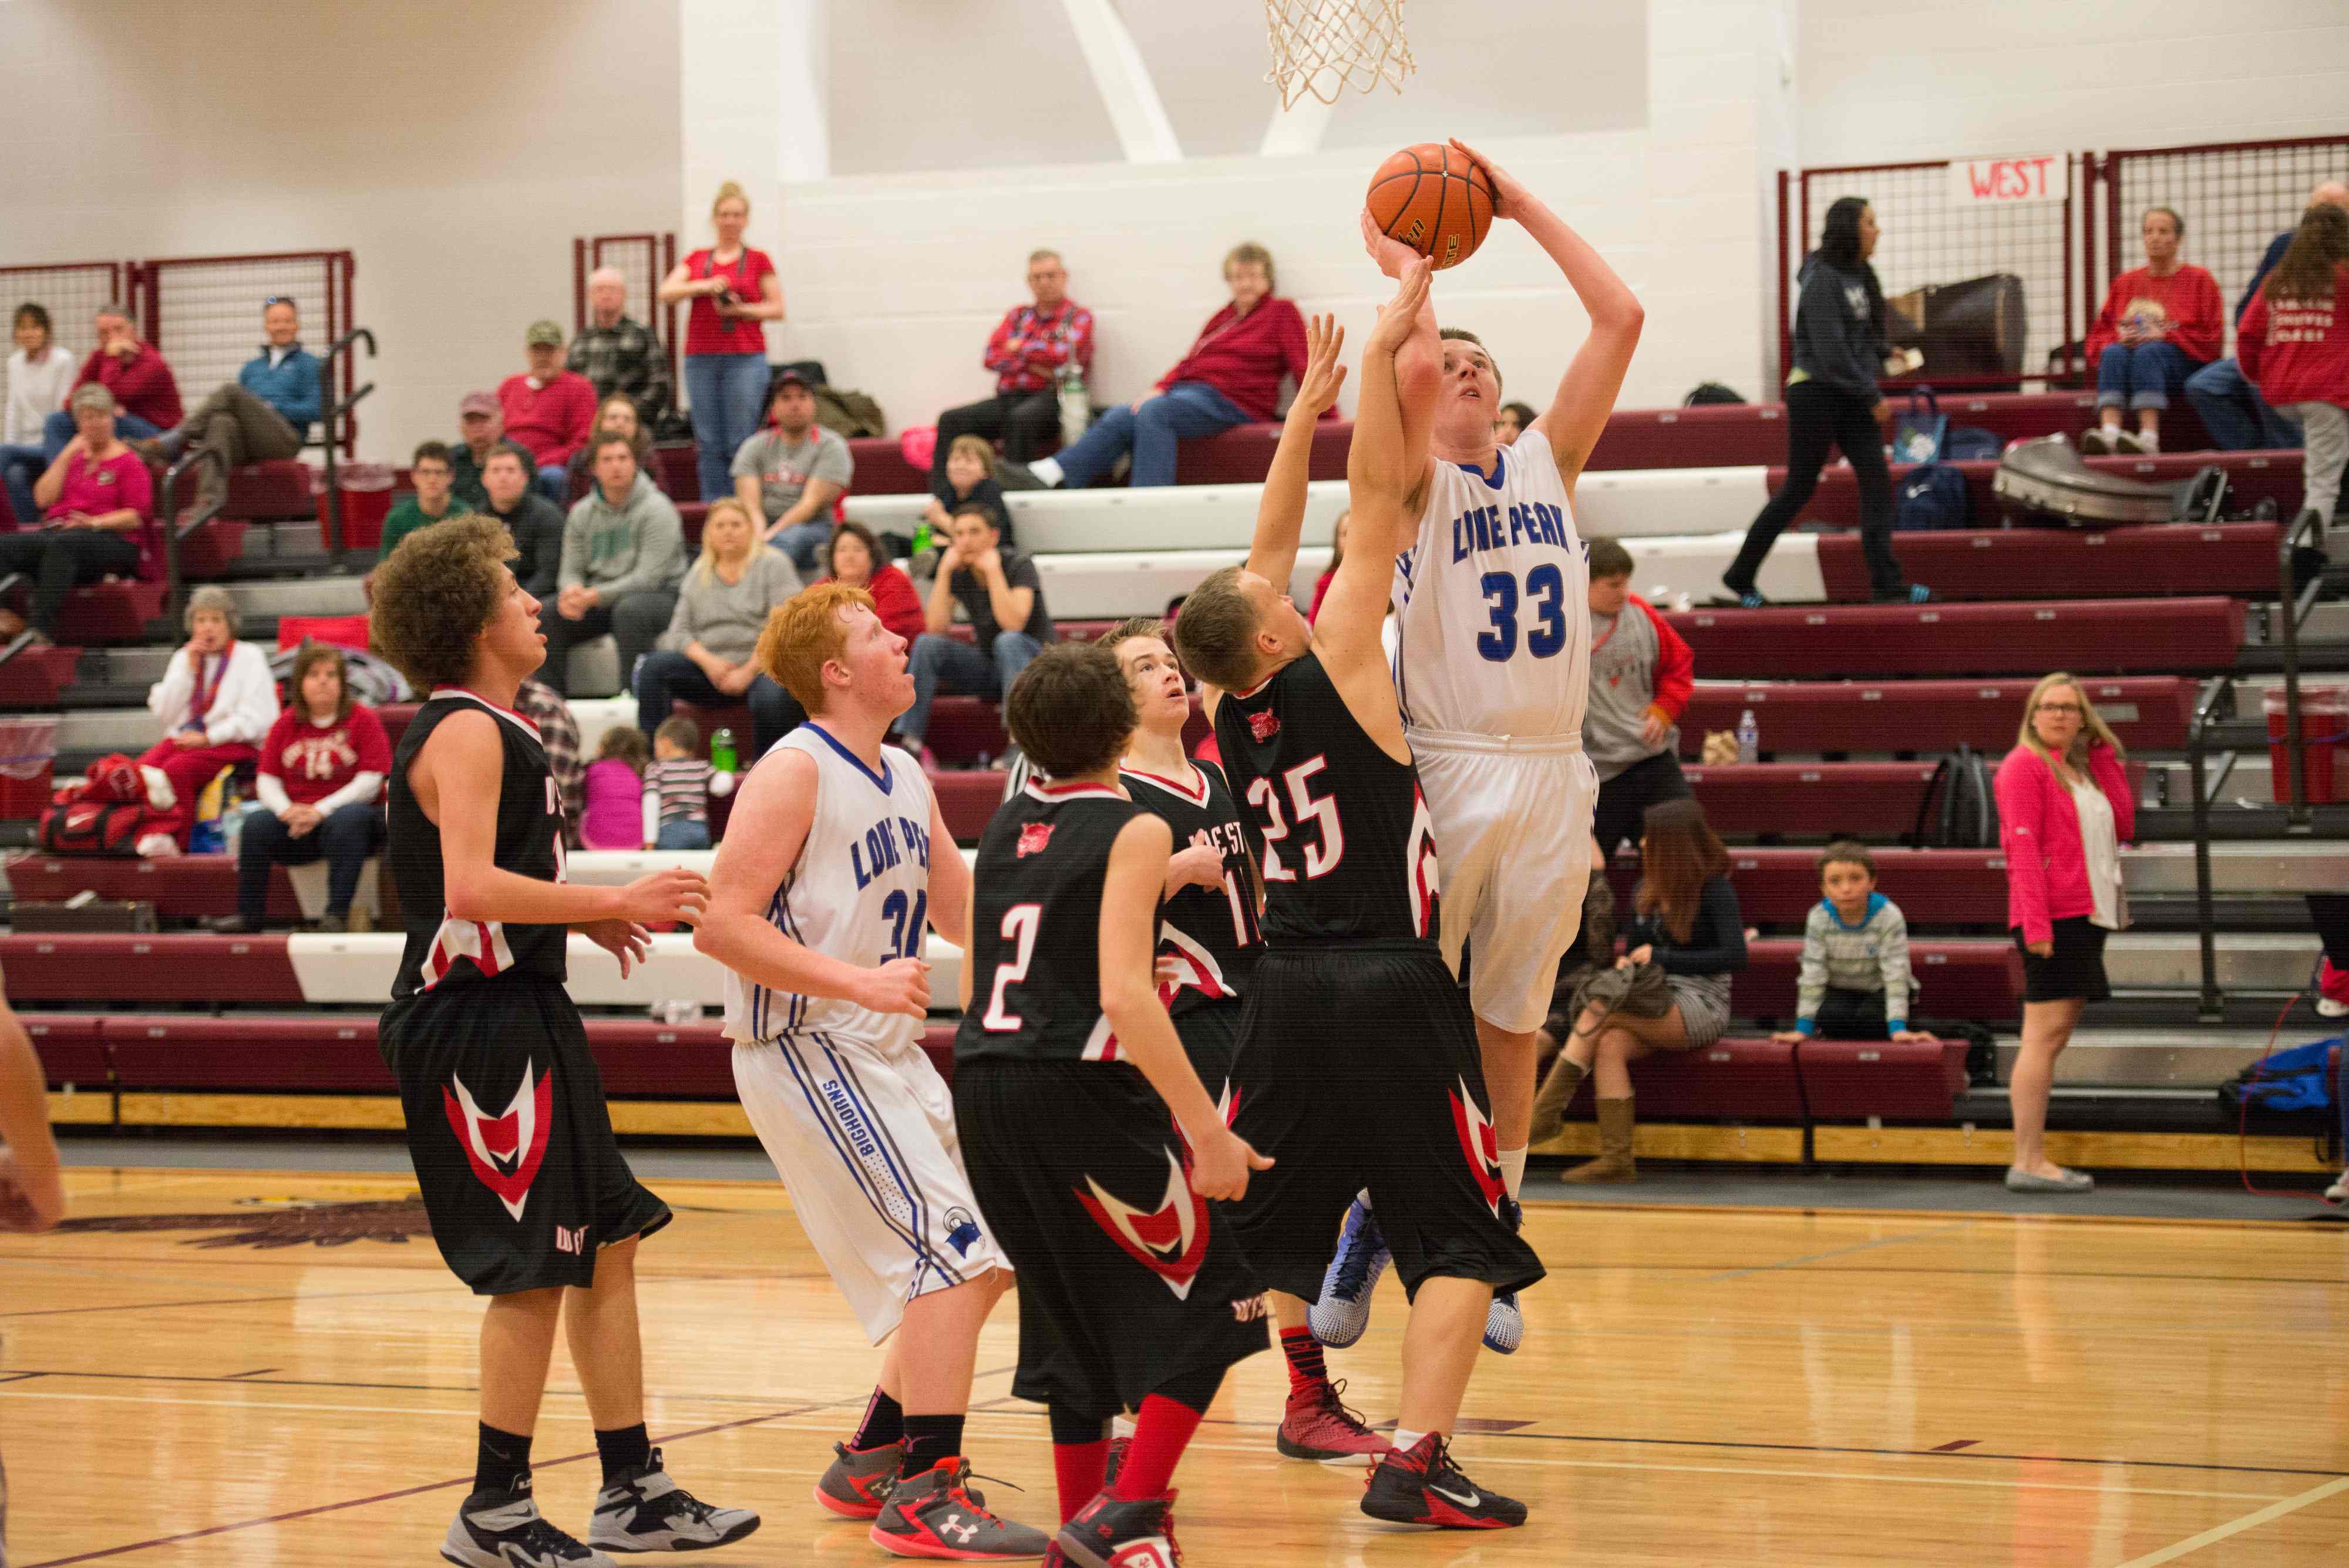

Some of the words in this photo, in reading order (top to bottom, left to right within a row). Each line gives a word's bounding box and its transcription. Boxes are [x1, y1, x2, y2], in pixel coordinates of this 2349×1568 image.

[1968, 155, 2054, 198] WEST
[1477, 563, 1566, 662] 33
[850, 817, 901, 892] LONE
[1246, 752, 1345, 883] 25
[982, 902, 1044, 1032] 2
[822, 1079, 875, 1157] BIGHORNS
